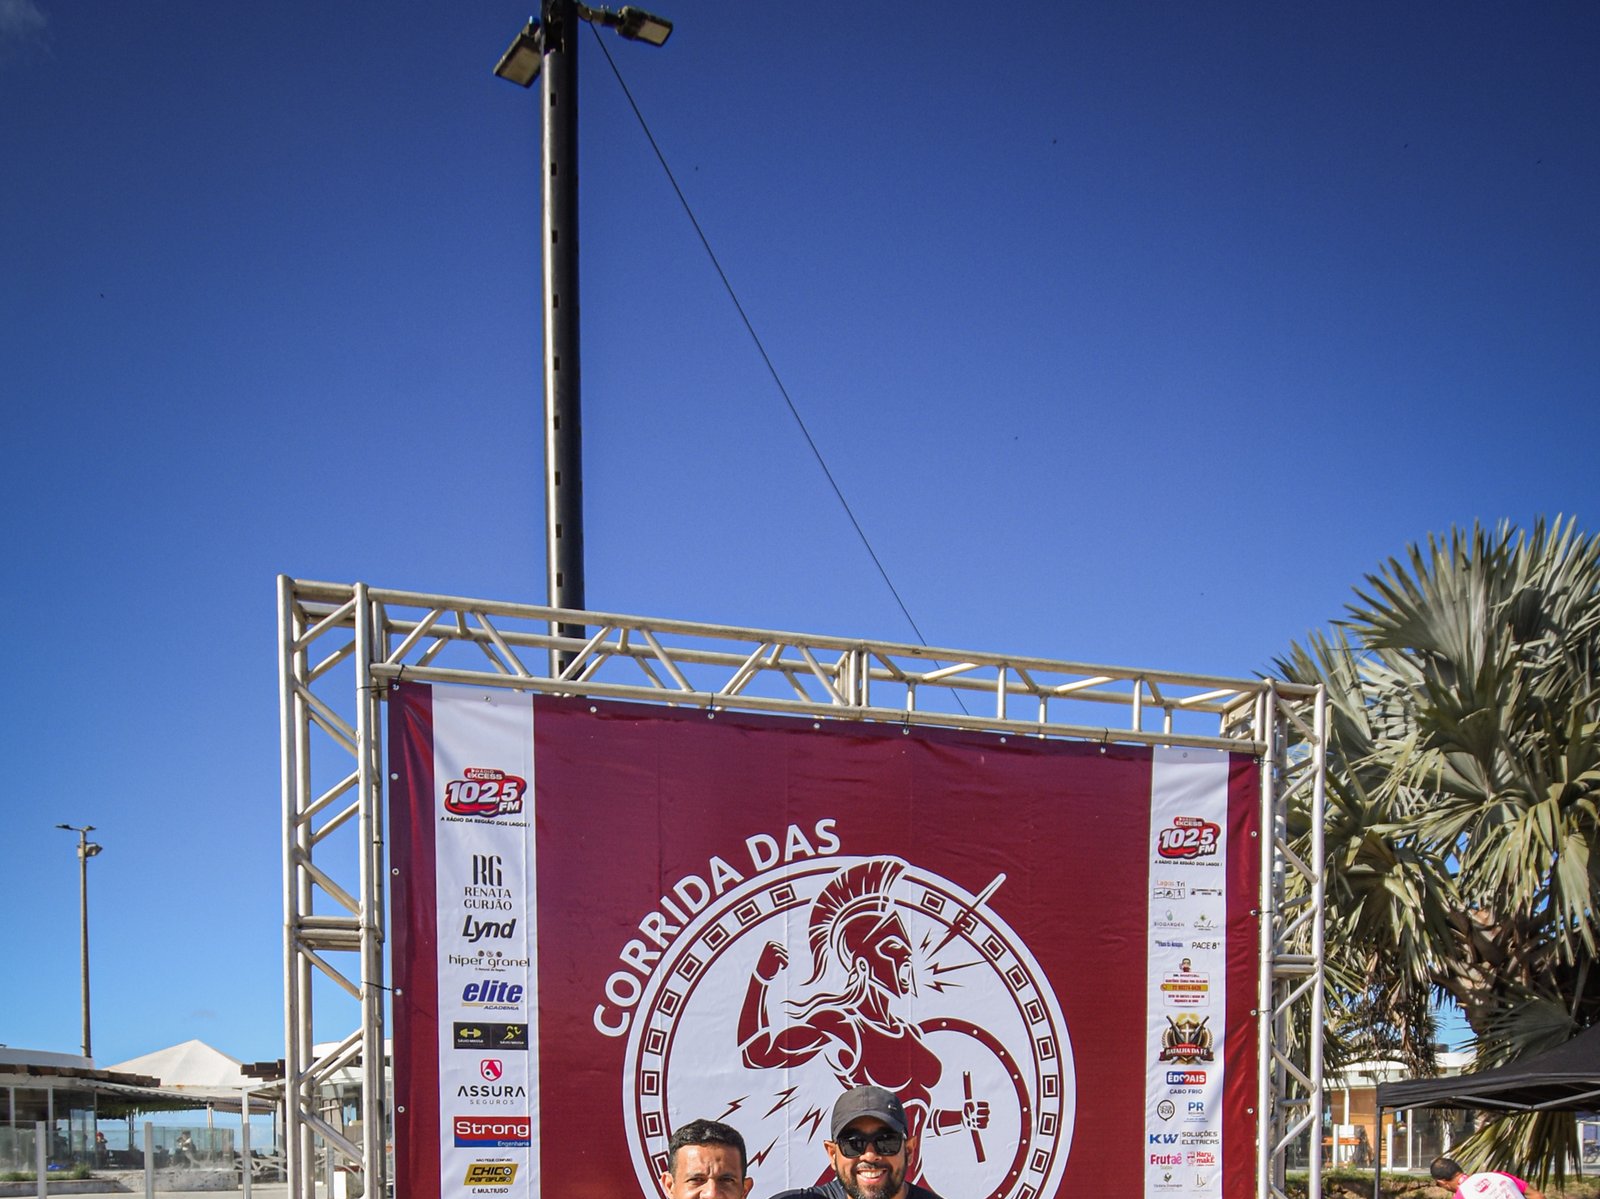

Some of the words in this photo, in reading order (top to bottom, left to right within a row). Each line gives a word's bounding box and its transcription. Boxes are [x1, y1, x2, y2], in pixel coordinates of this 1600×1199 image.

[498, 801, 520, 812] FM
[745, 818, 841, 872] DAS
[1198, 844, 1215, 854] FM
[464, 886, 512, 899] RENATA
[464, 899, 512, 911] GURJÃO
[462, 914, 517, 943] Lynd
[593, 855, 744, 1037] CORRIDA
[1192, 942, 1210, 950] PACE
[448, 954, 484, 967] hiper
[488, 957, 530, 968] granel
[462, 980, 523, 1003] elite
[457, 1085, 526, 1098] ASSURA
[1188, 1102, 1204, 1112] PR
[456, 1120, 530, 1138] Strong
[1182, 1130, 1218, 1138] SOLUÇÕES
[497, 1140, 530, 1148] Engenharia
[1150, 1134, 1179, 1145] KW
